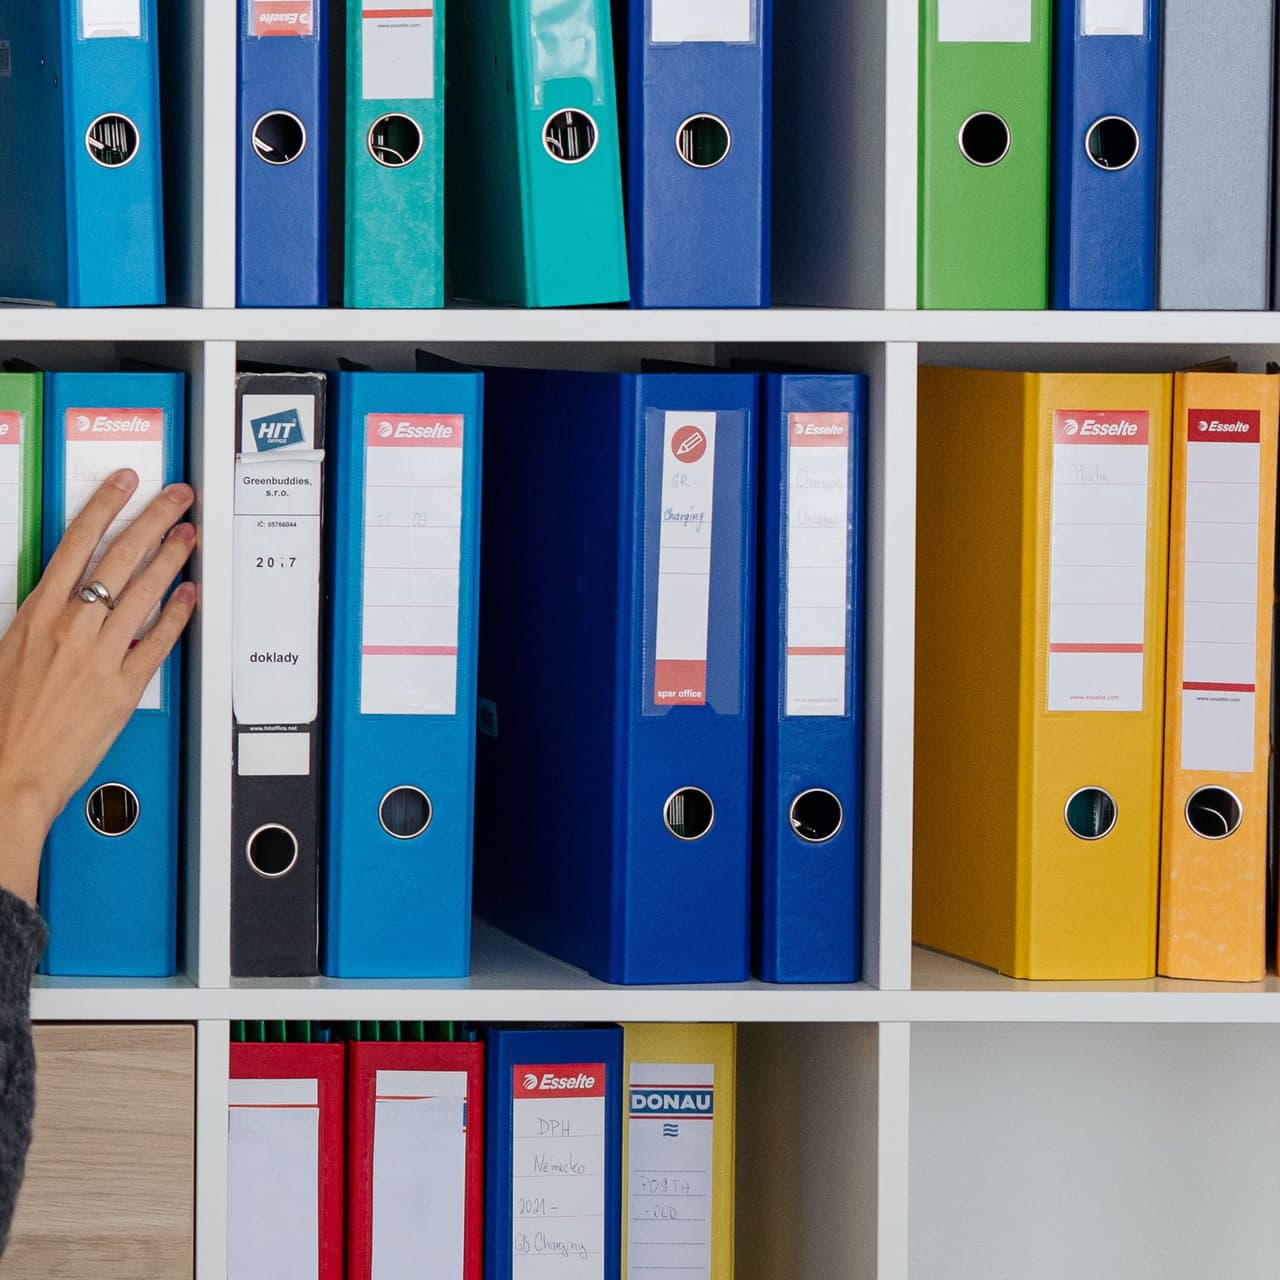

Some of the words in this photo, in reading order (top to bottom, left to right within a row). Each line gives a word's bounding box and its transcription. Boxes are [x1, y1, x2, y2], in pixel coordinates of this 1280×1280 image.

[259, 12, 298, 25] Esselte
[92, 416, 151, 433] Esselte
[257, 421, 296, 439] HIT
[394, 421, 453, 439] Esselte
[804, 423, 844, 435] Esselte
[1080, 419, 1138, 437] Esselte
[1208, 420, 1250, 433] Esselte
[242, 475, 314, 488] Greenbuddies,
[265, 488, 290, 498] s.r.o.
[663, 506, 705, 534] Charging
[248, 651, 300, 666] doklady
[657, 689, 677, 700] spar
[678, 688, 703, 699] office
[539, 1072, 595, 1089] Esselte
[631, 1093, 711, 1111] DONAU
[537, 1116, 571, 1137] DPH
[519, 1198, 546, 1216] 2021
[514, 1232, 531, 1253] GB
[534, 1231, 589, 1260] Charging
